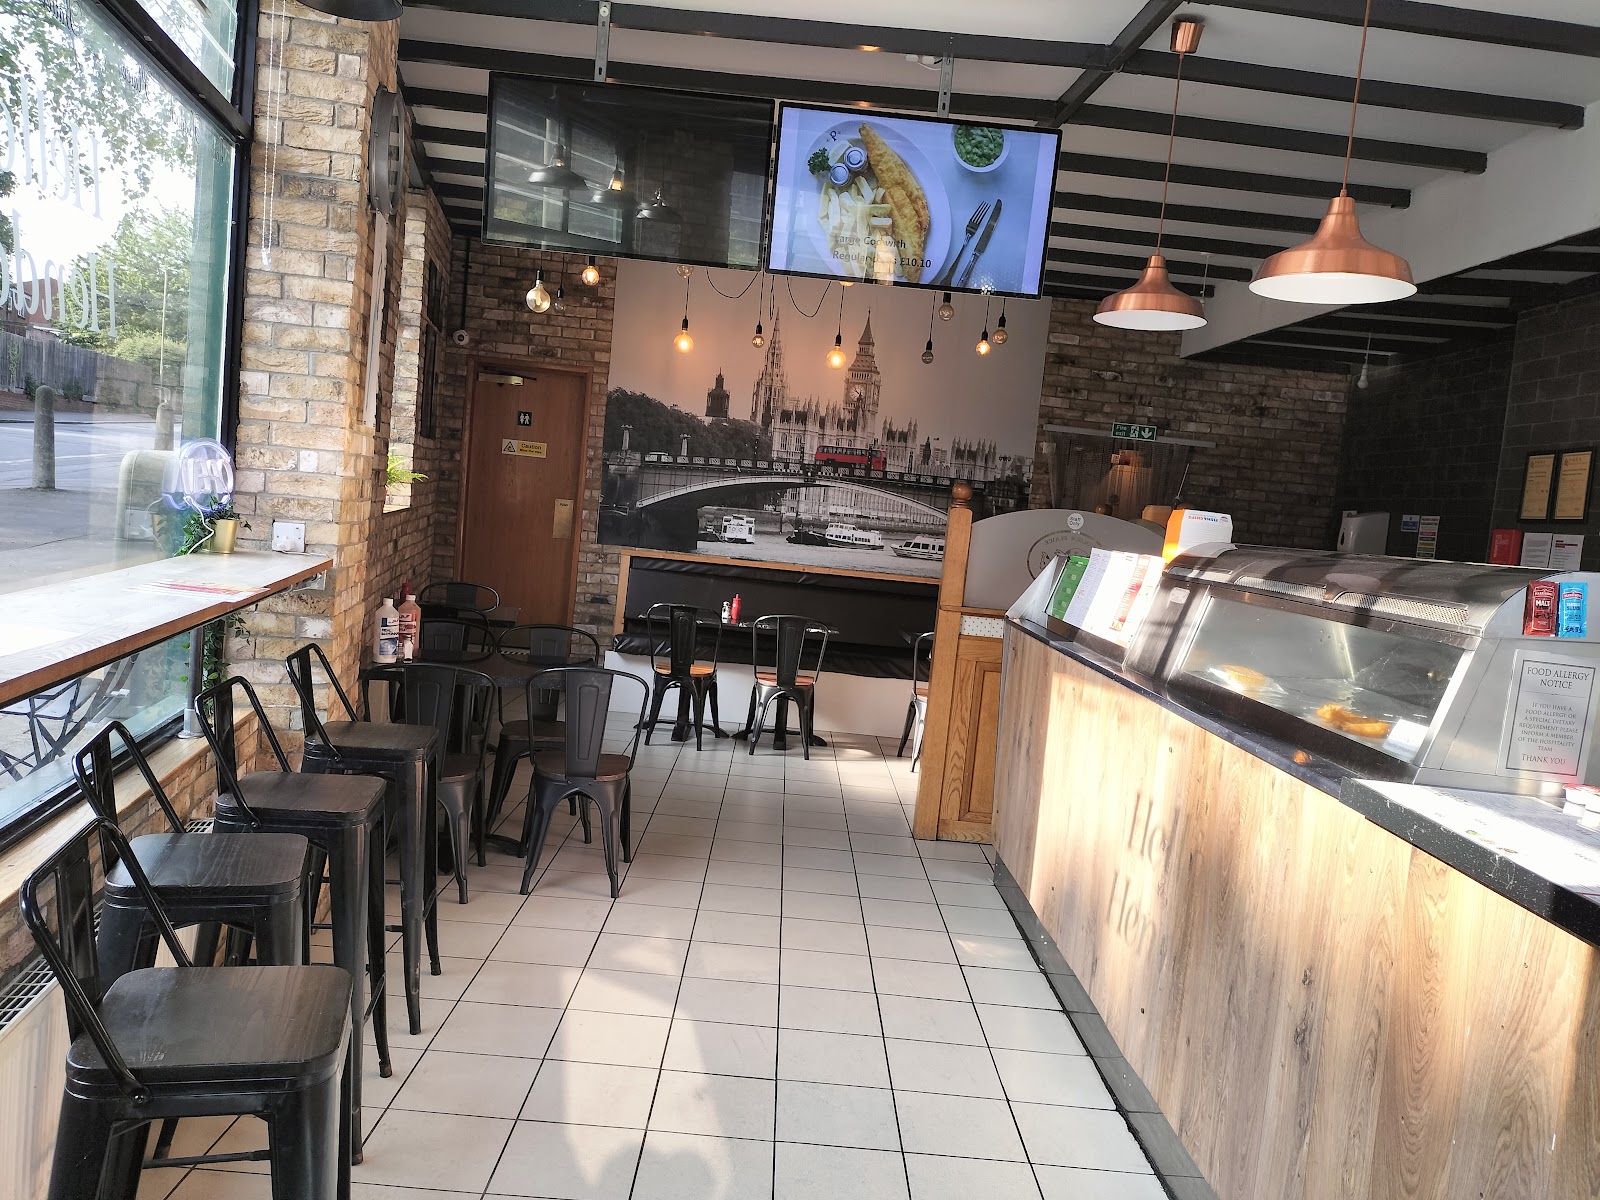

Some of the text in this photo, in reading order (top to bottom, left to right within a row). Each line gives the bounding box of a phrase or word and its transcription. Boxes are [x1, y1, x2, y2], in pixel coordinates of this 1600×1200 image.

[899, 257, 932, 269] £10.10
[1526, 666, 1590, 681] FOOD ALLERGY
[1540, 679, 1573, 689] NOTICE
[1519, 722, 1559, 731] REQUIREMENT
[1539, 739, 1575, 747] HOSPITALITY
[1521, 753, 1566, 765] THANK YOU
